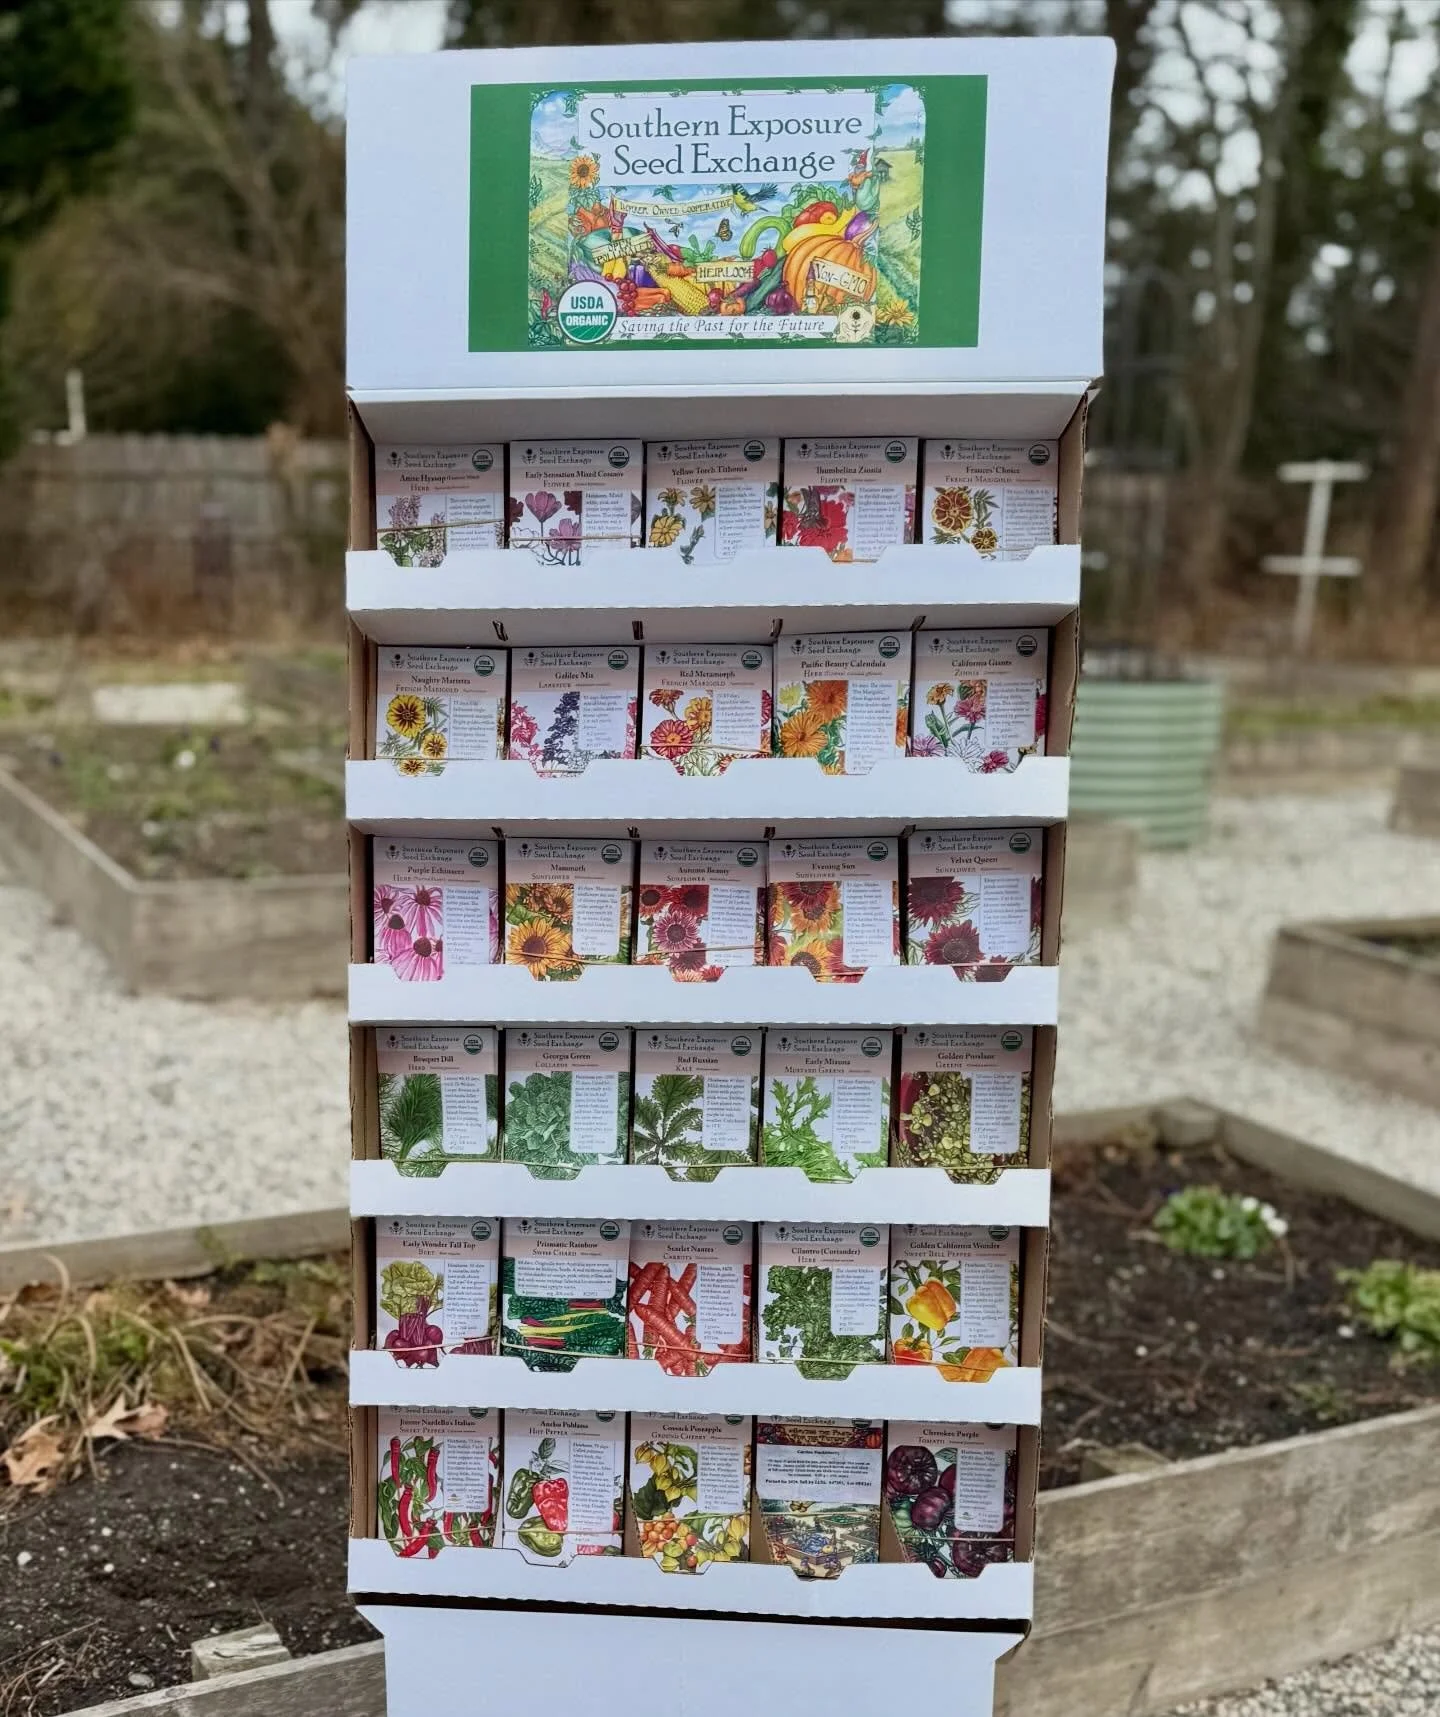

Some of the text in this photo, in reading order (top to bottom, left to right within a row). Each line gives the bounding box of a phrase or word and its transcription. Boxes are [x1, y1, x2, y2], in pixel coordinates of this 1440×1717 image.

[589, 105, 862, 142] Southern Exposure
[613, 143, 835, 179] Seed Exchange
[571, 296, 603, 309] USDA
[566, 315, 608, 326] ORGANIC
[619, 317, 825, 334] Saving the Past for the Future
